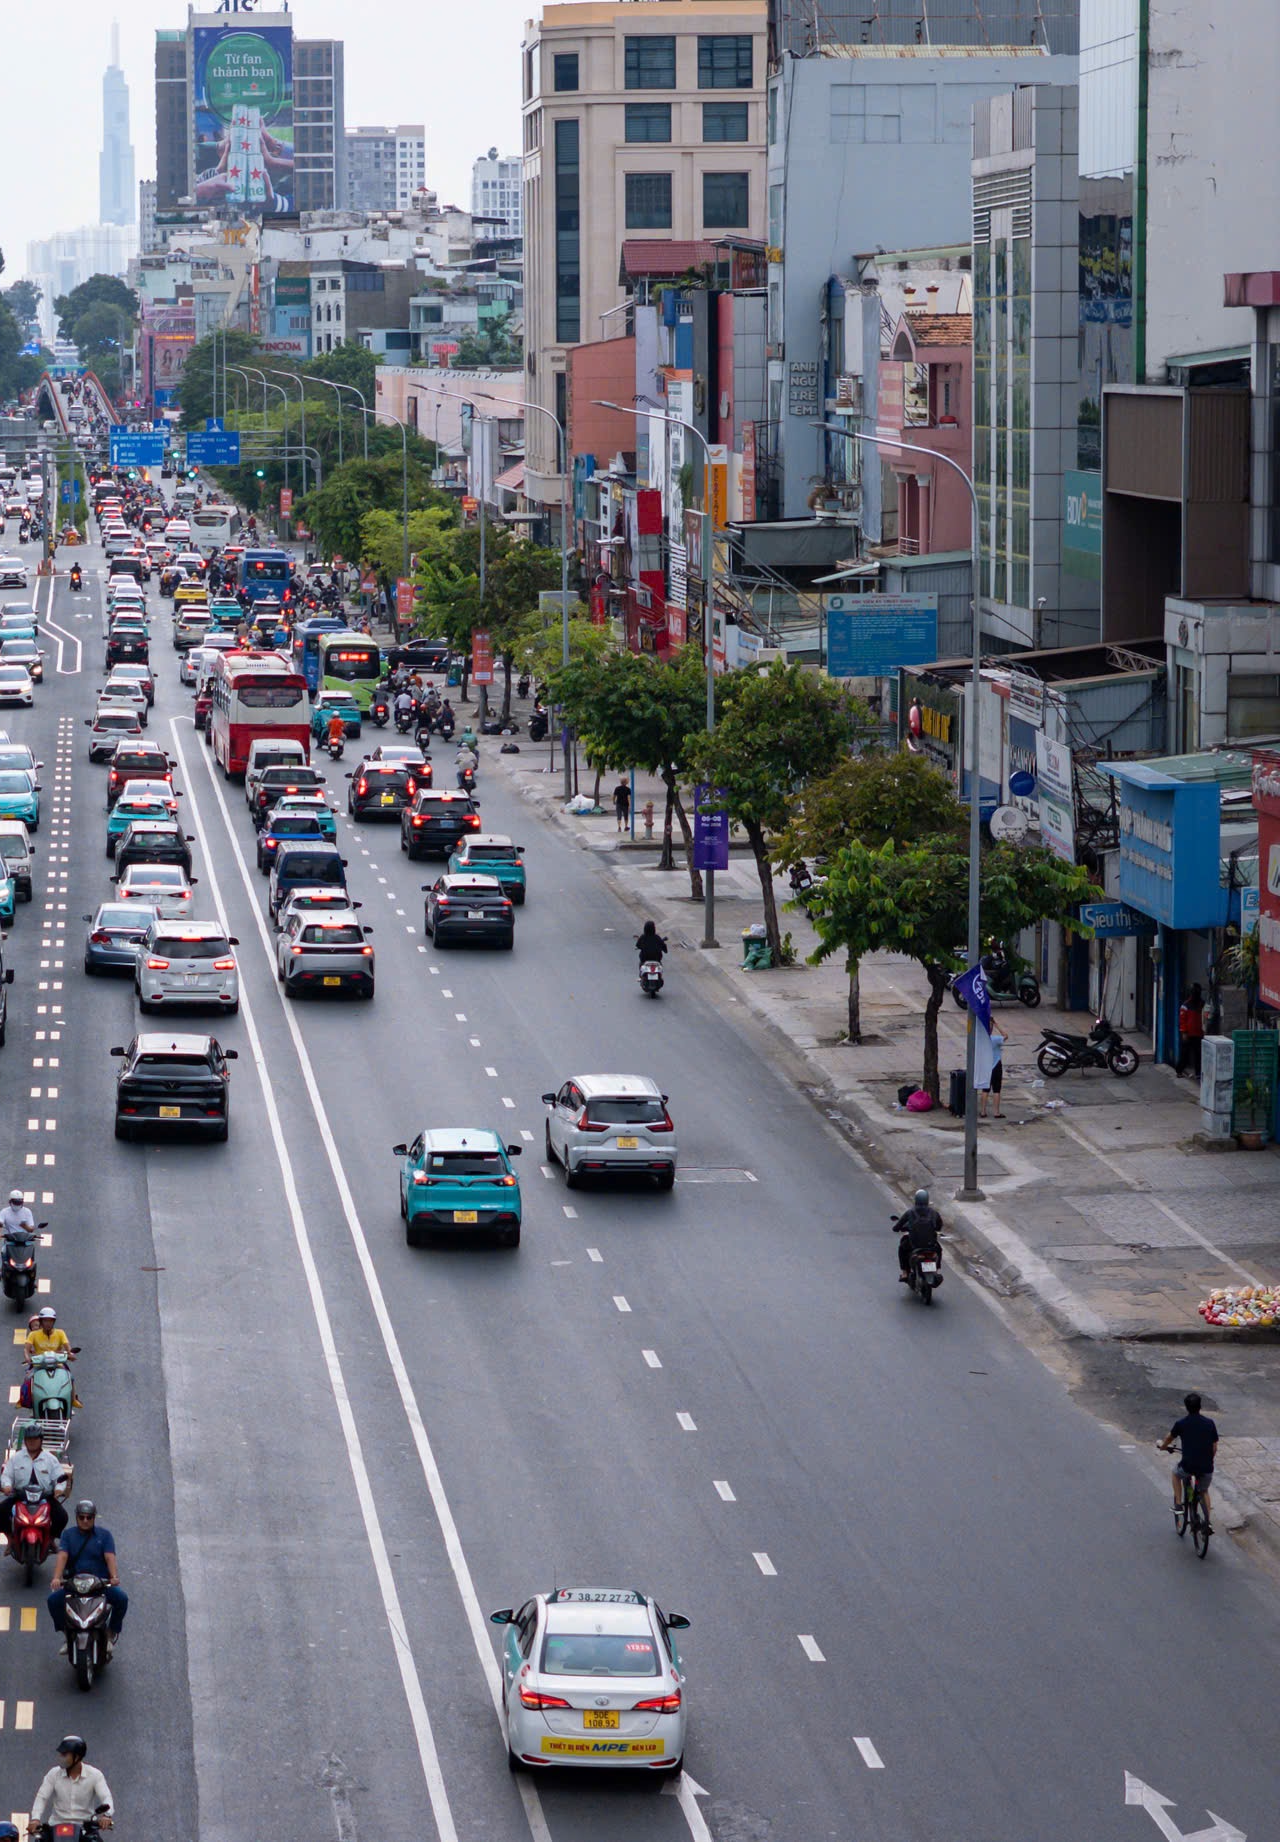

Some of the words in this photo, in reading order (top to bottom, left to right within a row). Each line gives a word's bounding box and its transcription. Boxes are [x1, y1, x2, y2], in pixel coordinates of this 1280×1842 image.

[243, 54, 262, 65] fan
[213, 66, 248, 77] thành
[252, 66, 274, 79] bạn
[792, 361, 817, 371] ANH
[795, 405, 813, 415] EM
[1116, 908, 1132, 930] thị
[592, 1743, 630, 1752] MPE
